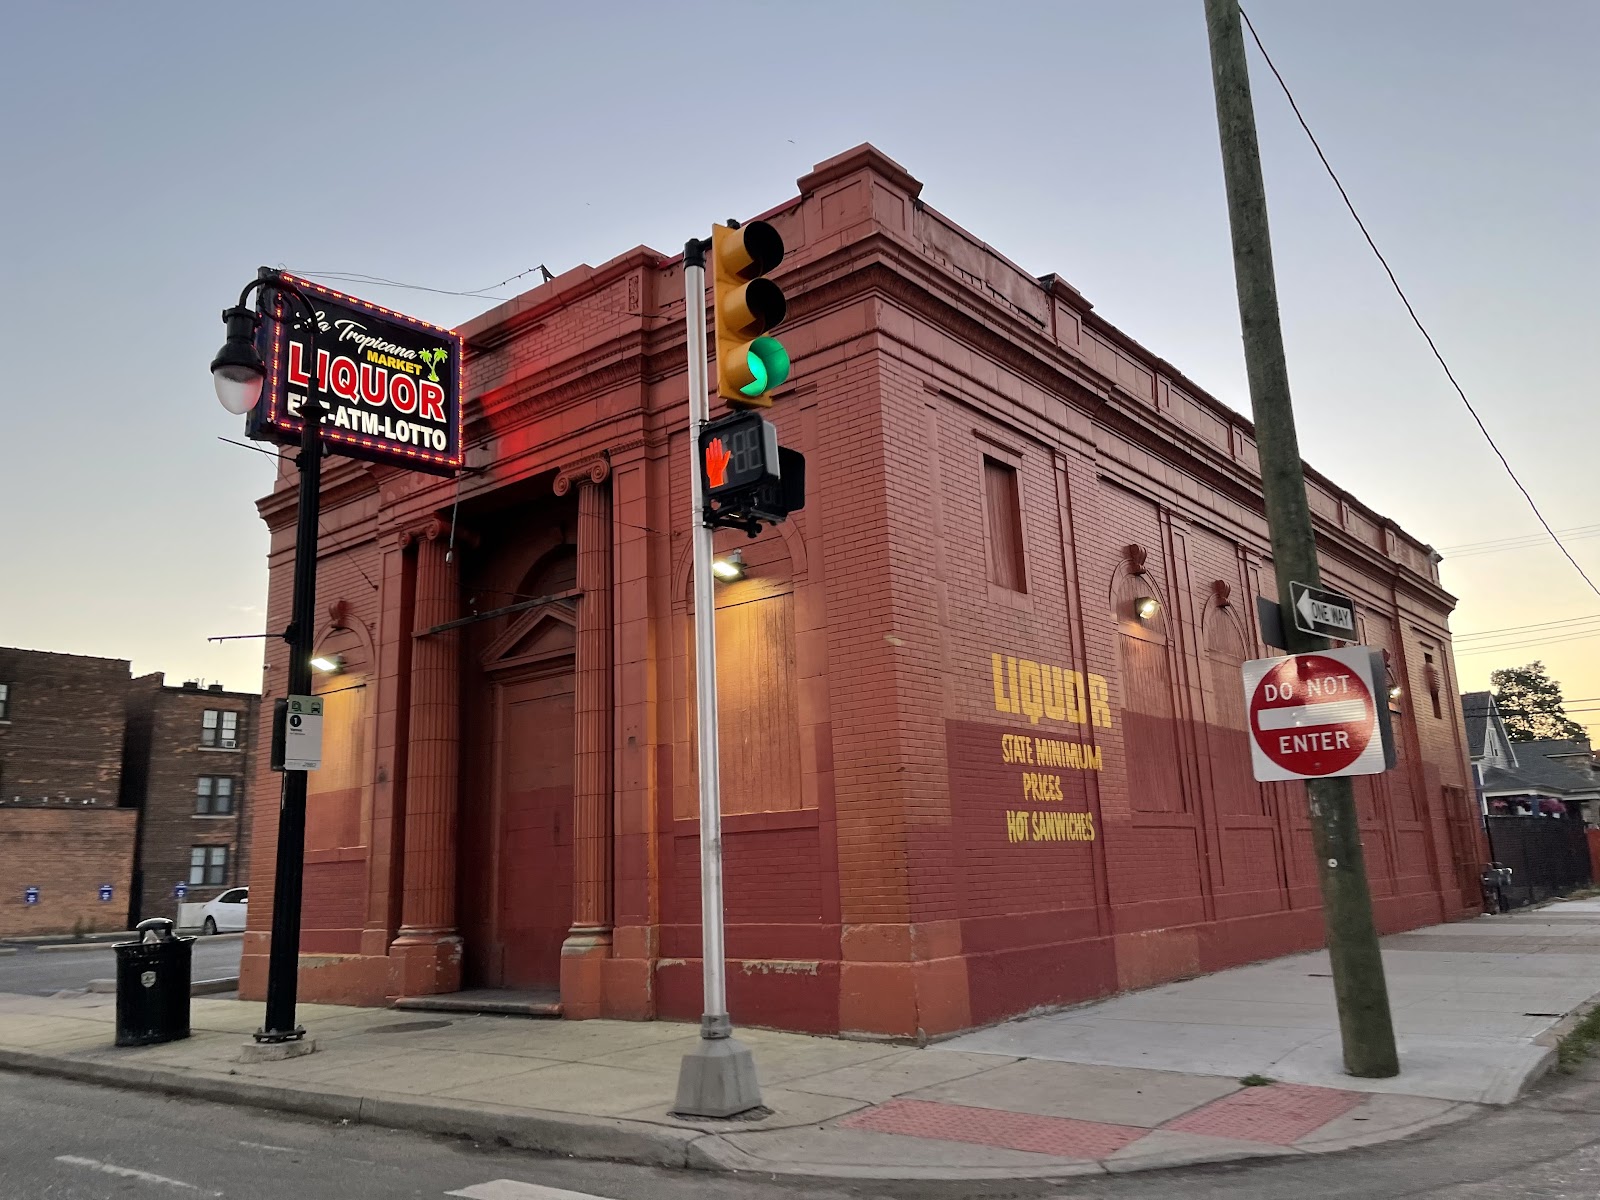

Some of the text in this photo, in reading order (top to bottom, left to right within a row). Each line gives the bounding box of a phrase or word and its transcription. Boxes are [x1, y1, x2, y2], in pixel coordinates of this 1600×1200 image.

[334, 319, 418, 360] Tropicana
[367, 350, 423, 376] MARKET
[288, 341, 447, 423] LIQUOR
[1311, 602, 1350, 627] ONE WAY
[991, 653, 1112, 728] LIQUOR
[1264, 674, 1350, 702] DO NOT
[1002, 733, 1103, 771] STATE MINIMUM
[1279, 731, 1350, 754] ENTER
[1022, 772, 1064, 801] PRICES
[1006, 810, 1095, 842] HOT SANWICHES
